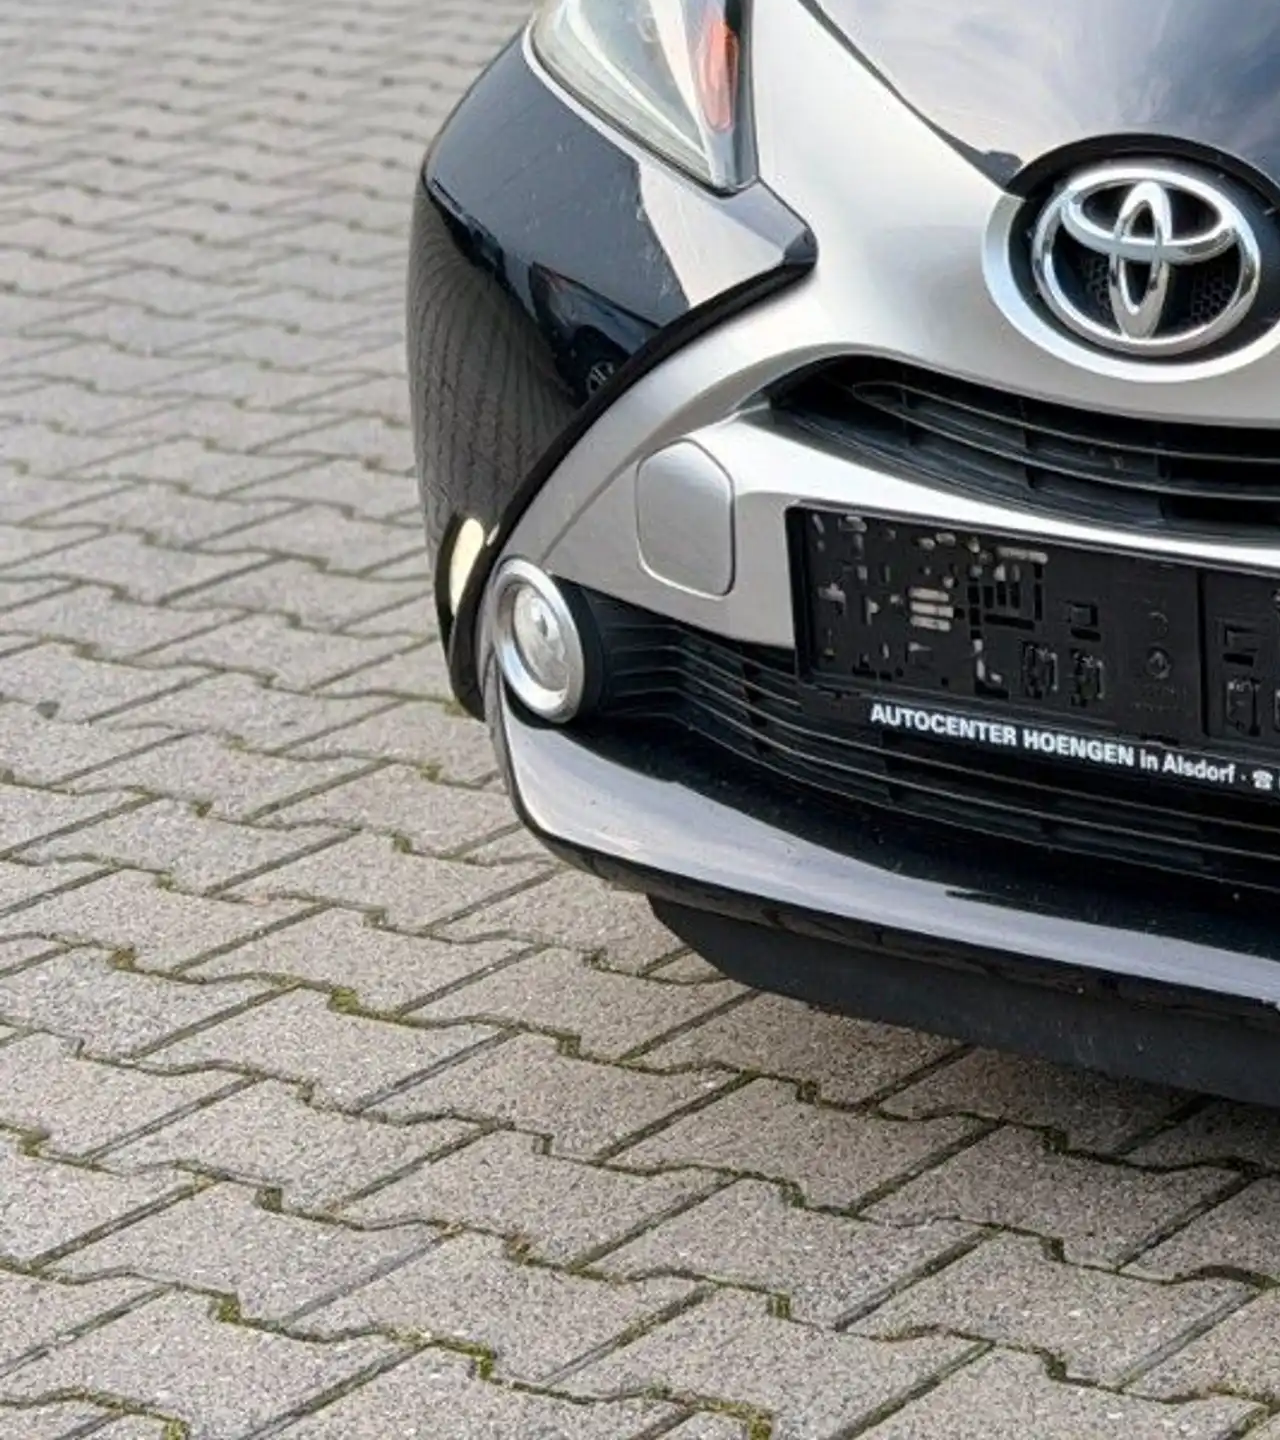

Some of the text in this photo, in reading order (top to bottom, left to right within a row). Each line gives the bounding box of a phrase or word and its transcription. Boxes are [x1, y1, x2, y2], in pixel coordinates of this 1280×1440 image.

[870, 702, 1018, 747] AUTOCENTER
[1022, 728, 1135, 767] HOENGEN
[1162, 754, 1236, 784] Alsdorf
